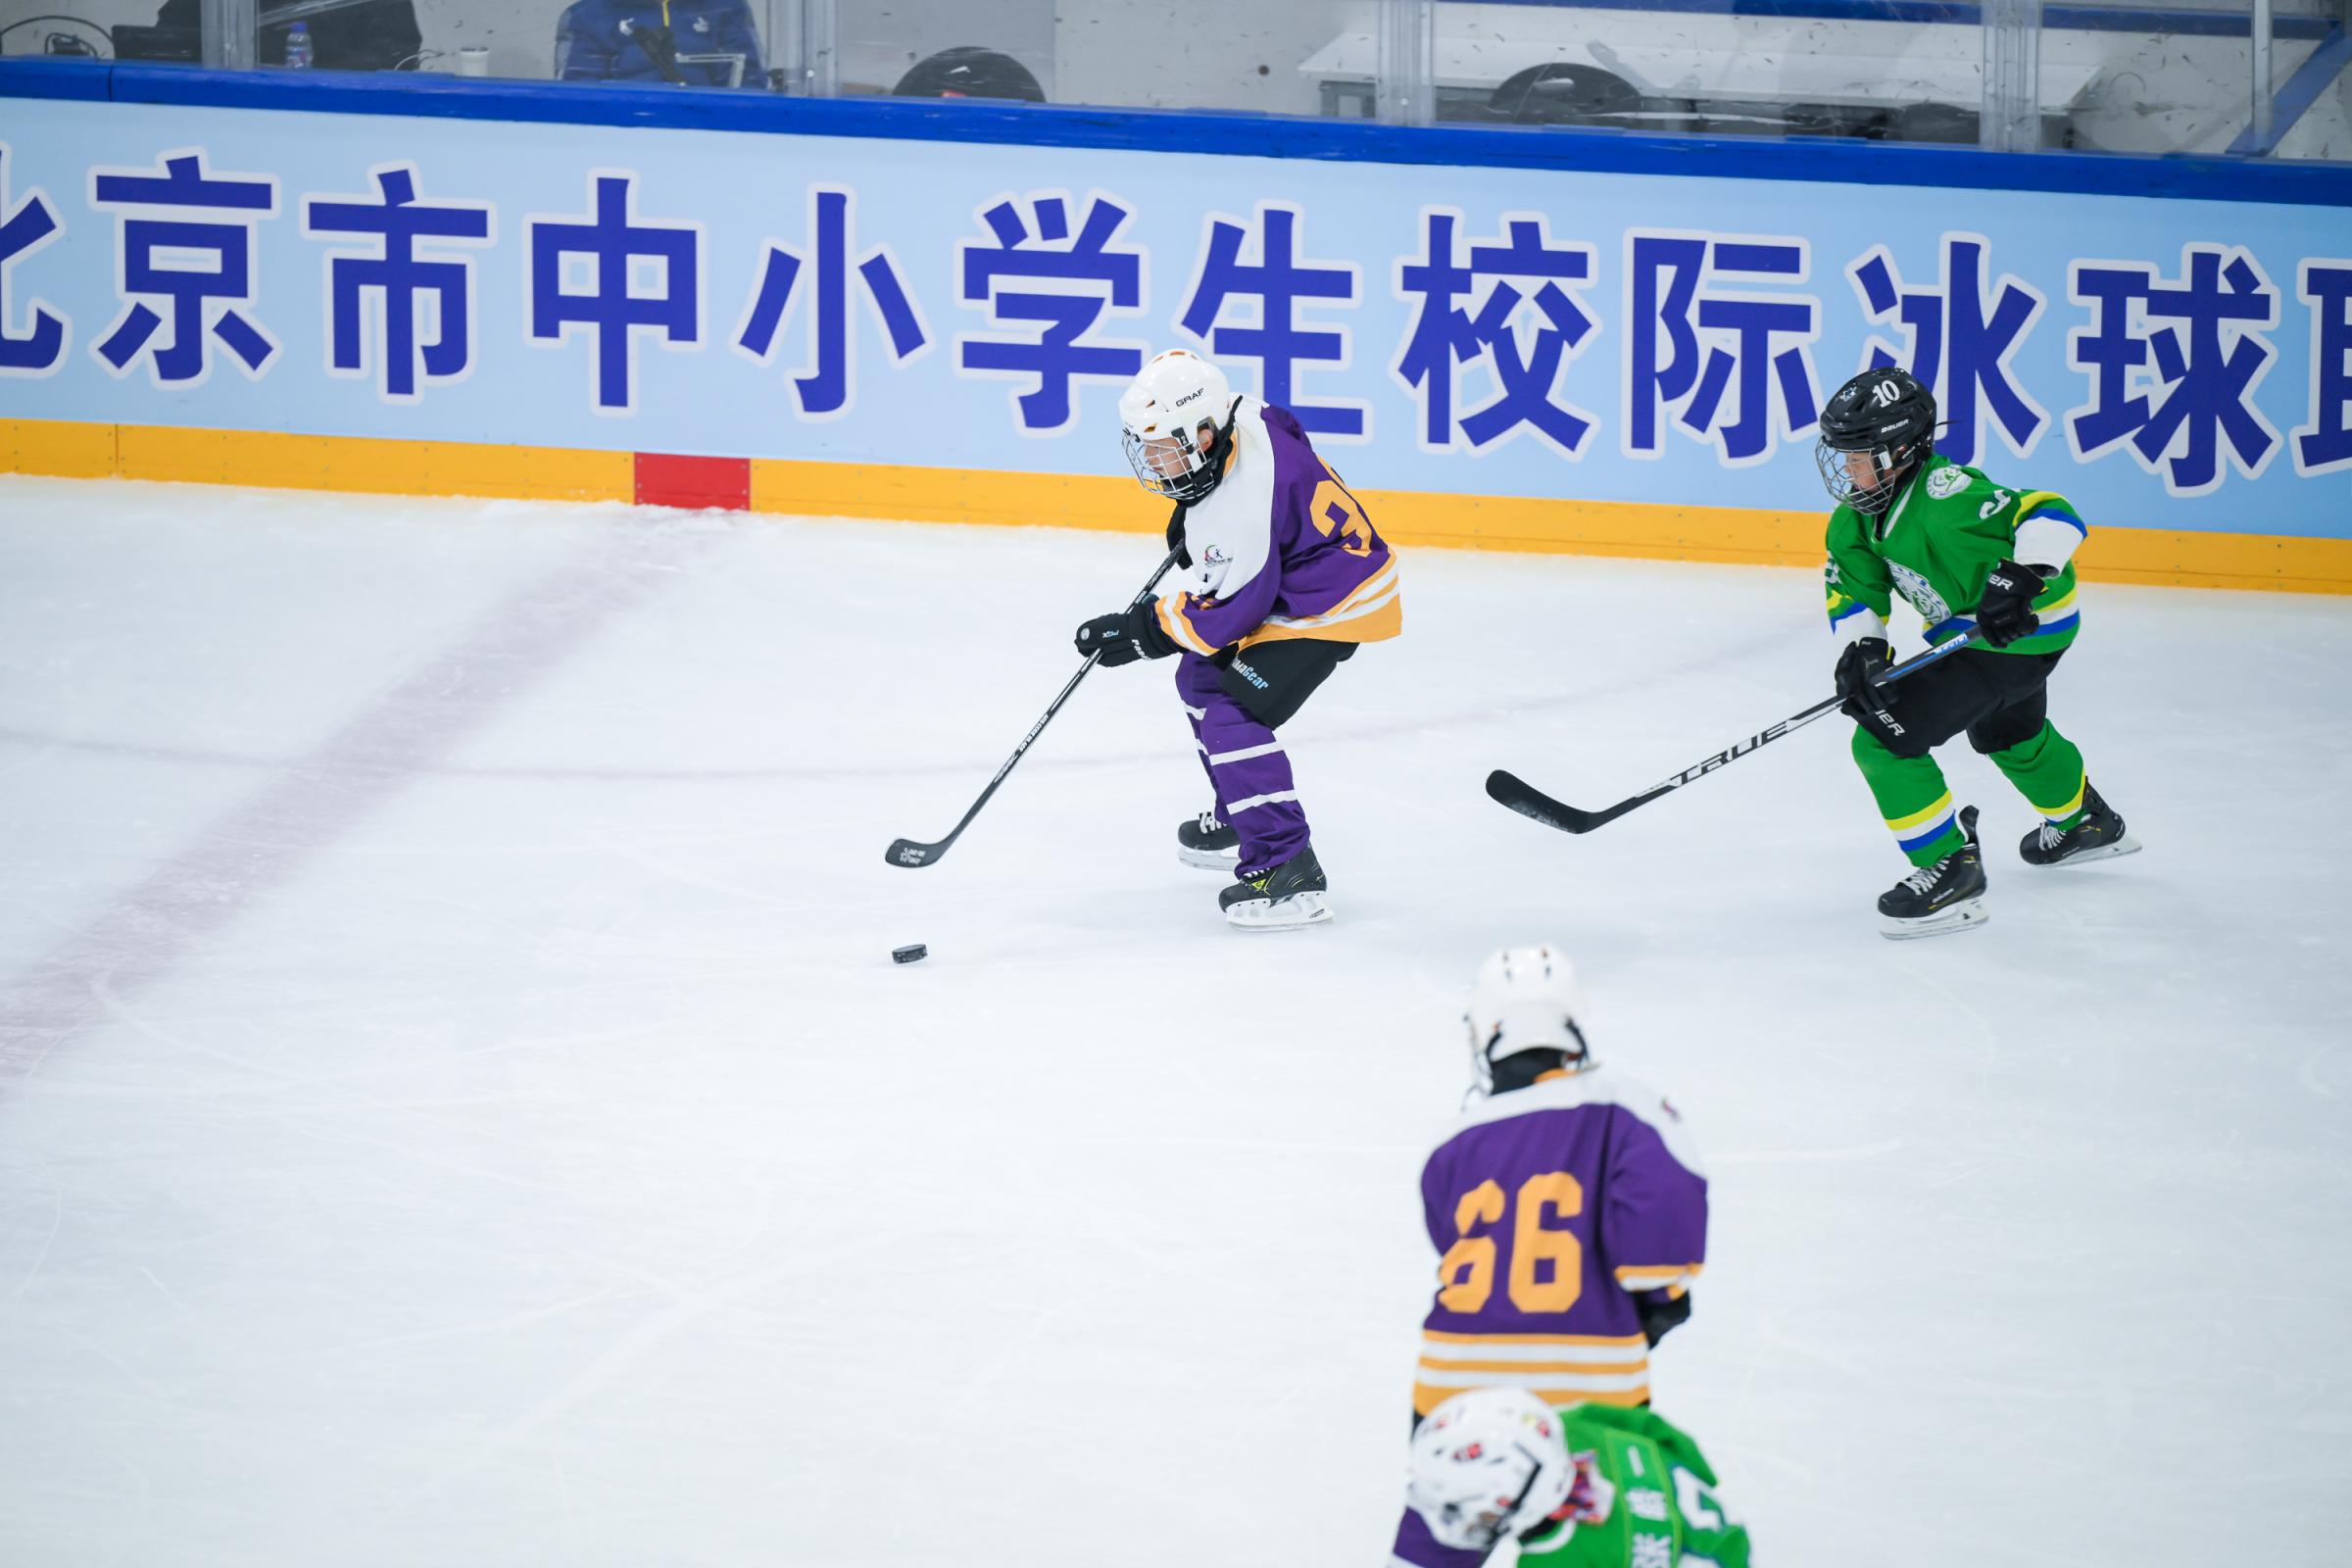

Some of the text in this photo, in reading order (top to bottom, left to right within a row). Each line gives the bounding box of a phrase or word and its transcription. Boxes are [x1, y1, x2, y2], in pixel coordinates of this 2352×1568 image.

[1175, 387, 1204, 408] GRAF
[1872, 379, 1900, 408] 10
[1669, 720, 1788, 785] TRUE
[1438, 1171, 1583, 1314] 66
